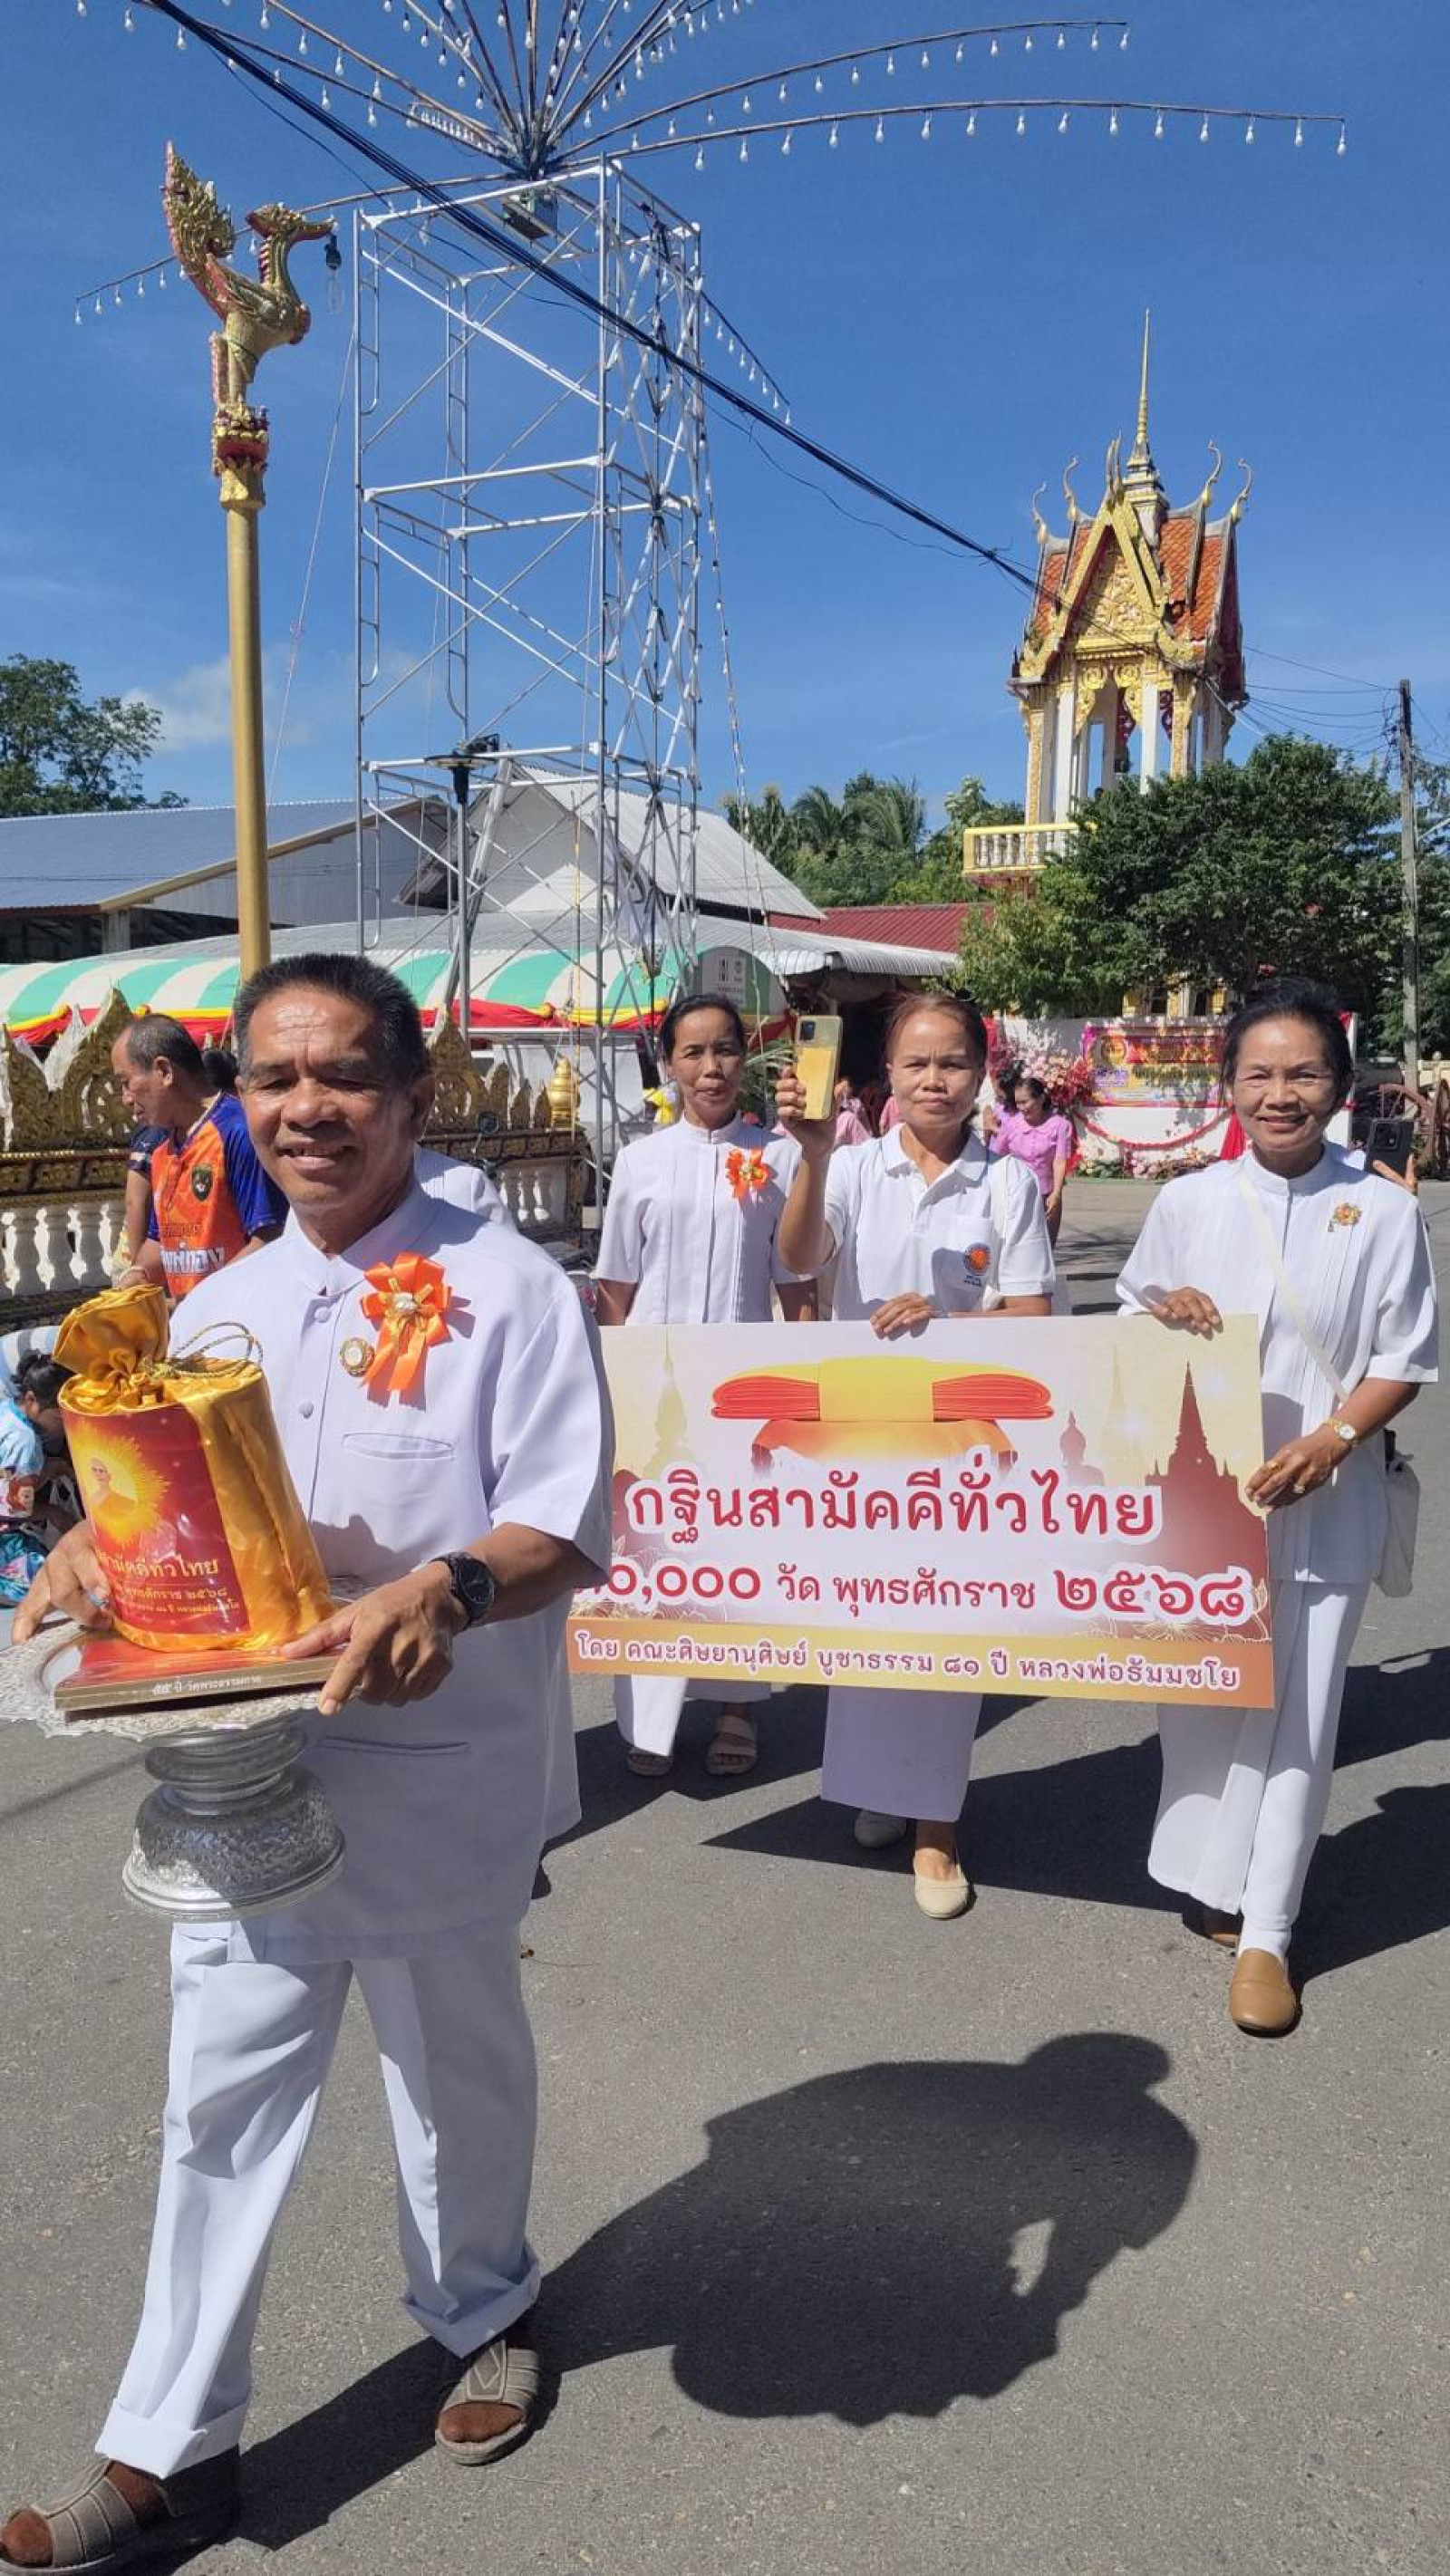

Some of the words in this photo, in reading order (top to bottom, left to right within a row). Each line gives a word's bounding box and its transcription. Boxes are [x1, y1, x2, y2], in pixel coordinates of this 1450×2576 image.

[632, 1452, 1155, 1544] กฐินสามัคคีทั่วไทย
[575, 1564, 761, 1605] ๐,๐๐๐
[778, 1563, 820, 1601] วัด
[834, 1565, 1035, 1617] พุทธศักราช
[1054, 1569, 1245, 1616] ๒๕๖๘
[578, 1634, 617, 1657] โดย
[627, 1639, 807, 1672] คณะศิษยานุศิษย์
[817, 1650, 933, 1675] บูชาธรรม
[944, 1657, 979, 1674] ๘๑
[991, 1652, 1008, 1674] ปี
[1020, 1655, 1238, 1687] หลวงพ่อธัมมชโย
